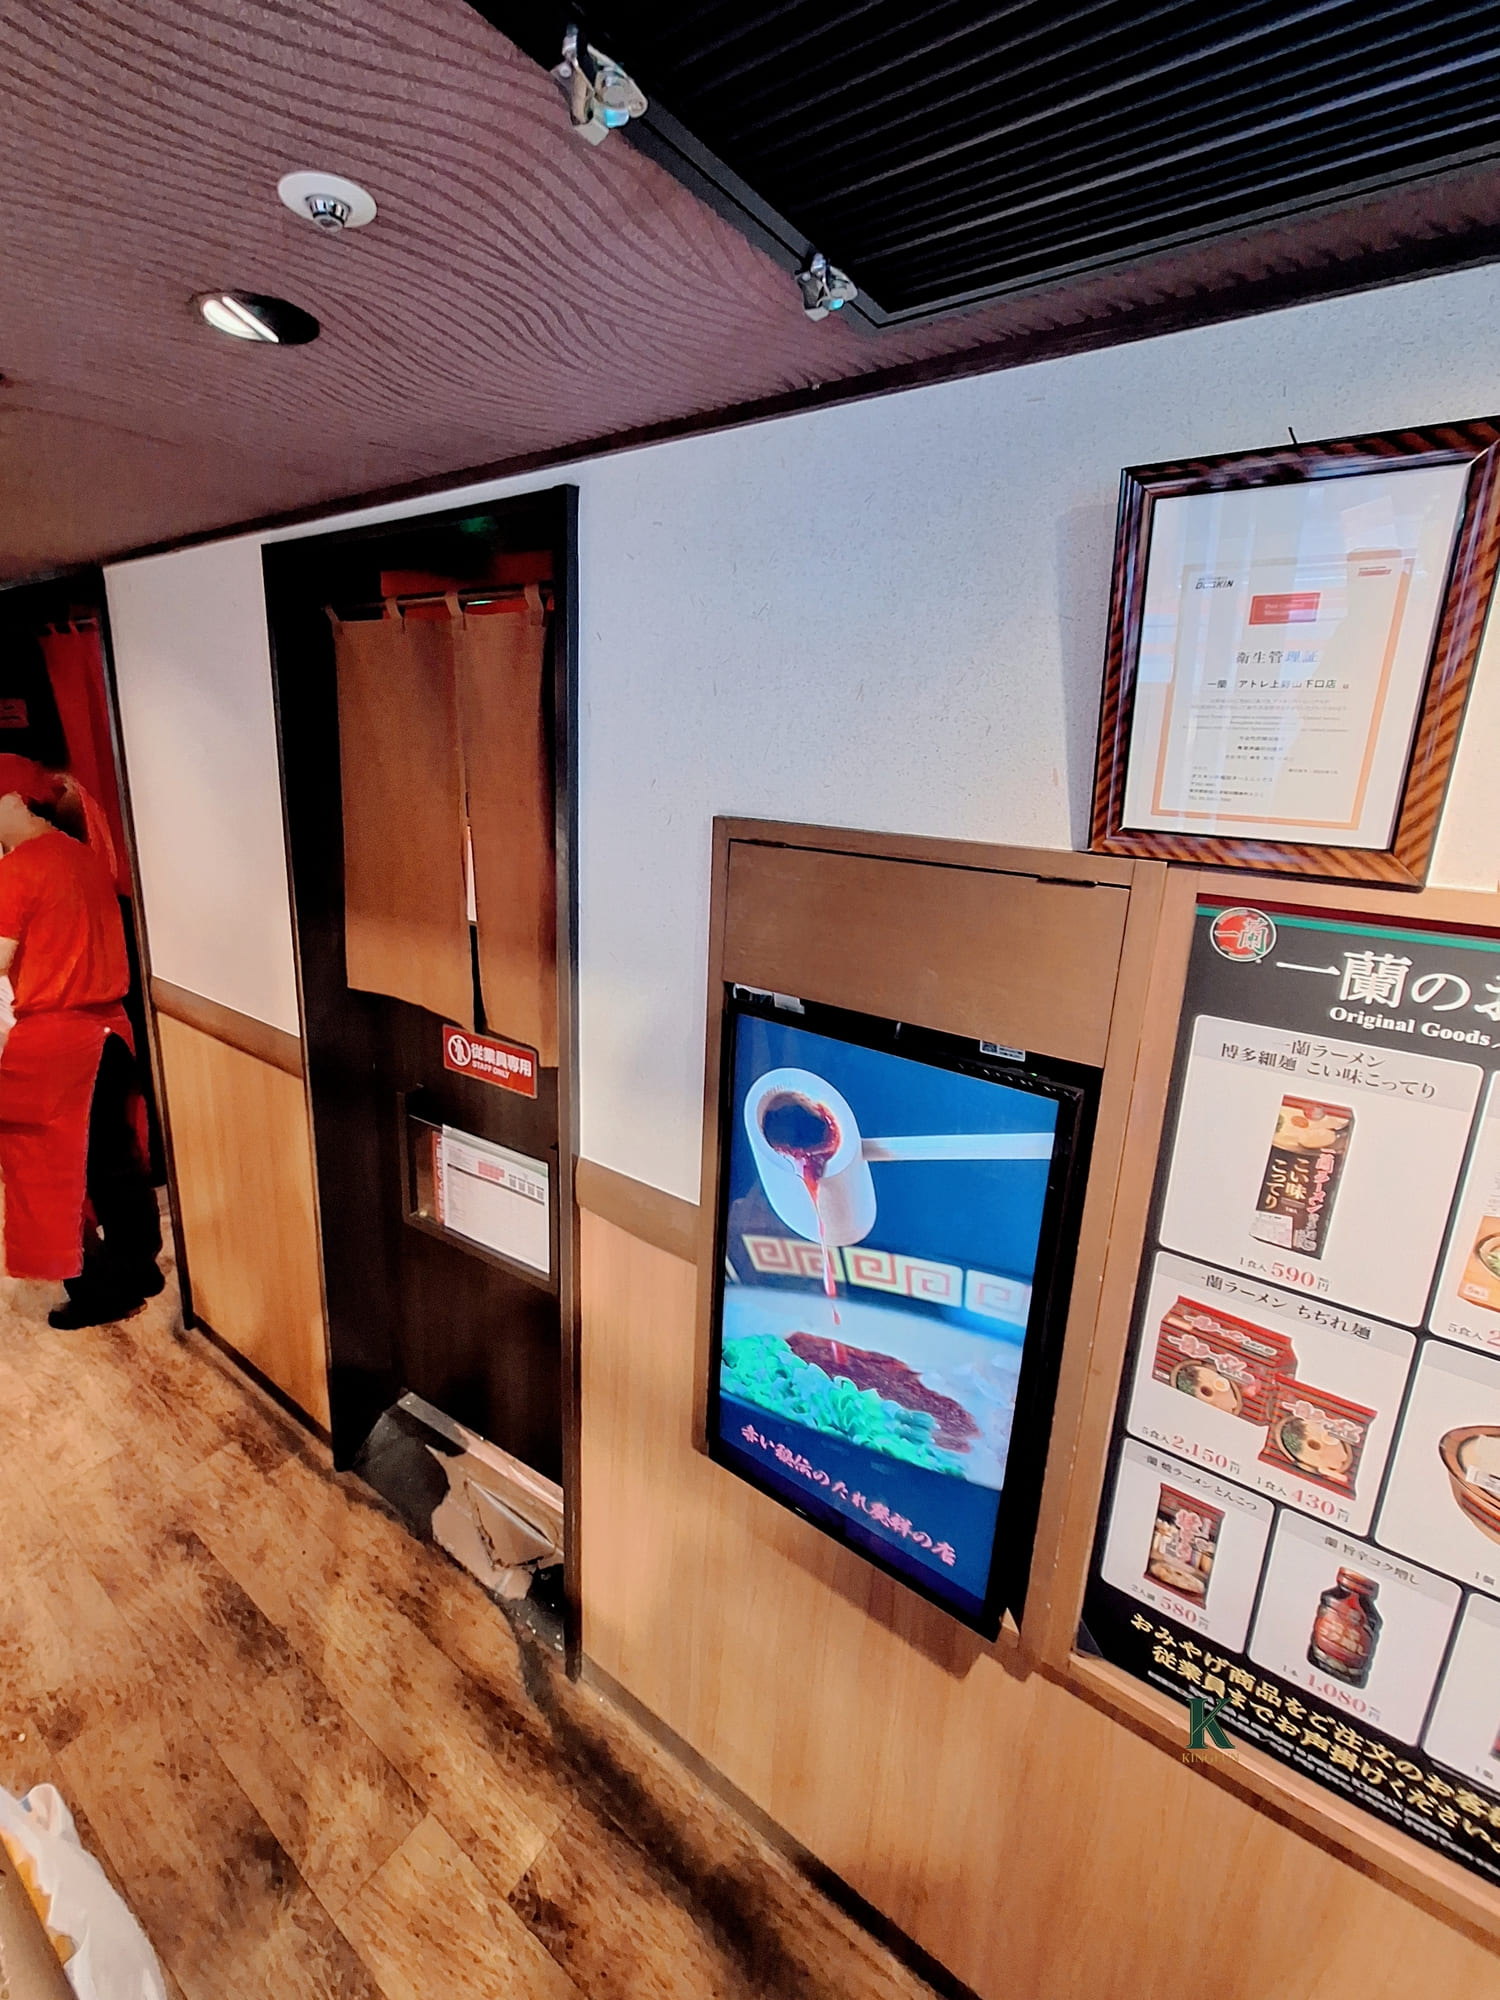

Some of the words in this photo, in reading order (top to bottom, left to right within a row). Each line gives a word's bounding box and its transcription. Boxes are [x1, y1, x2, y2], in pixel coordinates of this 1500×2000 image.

[1236, 651, 1319, 664] 衛生管理証
[1329, 1006, 1416, 1034] Original
[1420, 1022, 1491, 1047] Goods
[471, 1042, 532, 1077] 従業員専用
[471, 1060, 493, 1073] STAFF
[492, 1066, 510, 1079] ONLY
[1306, 1061, 1436, 1098] こい味こってり
